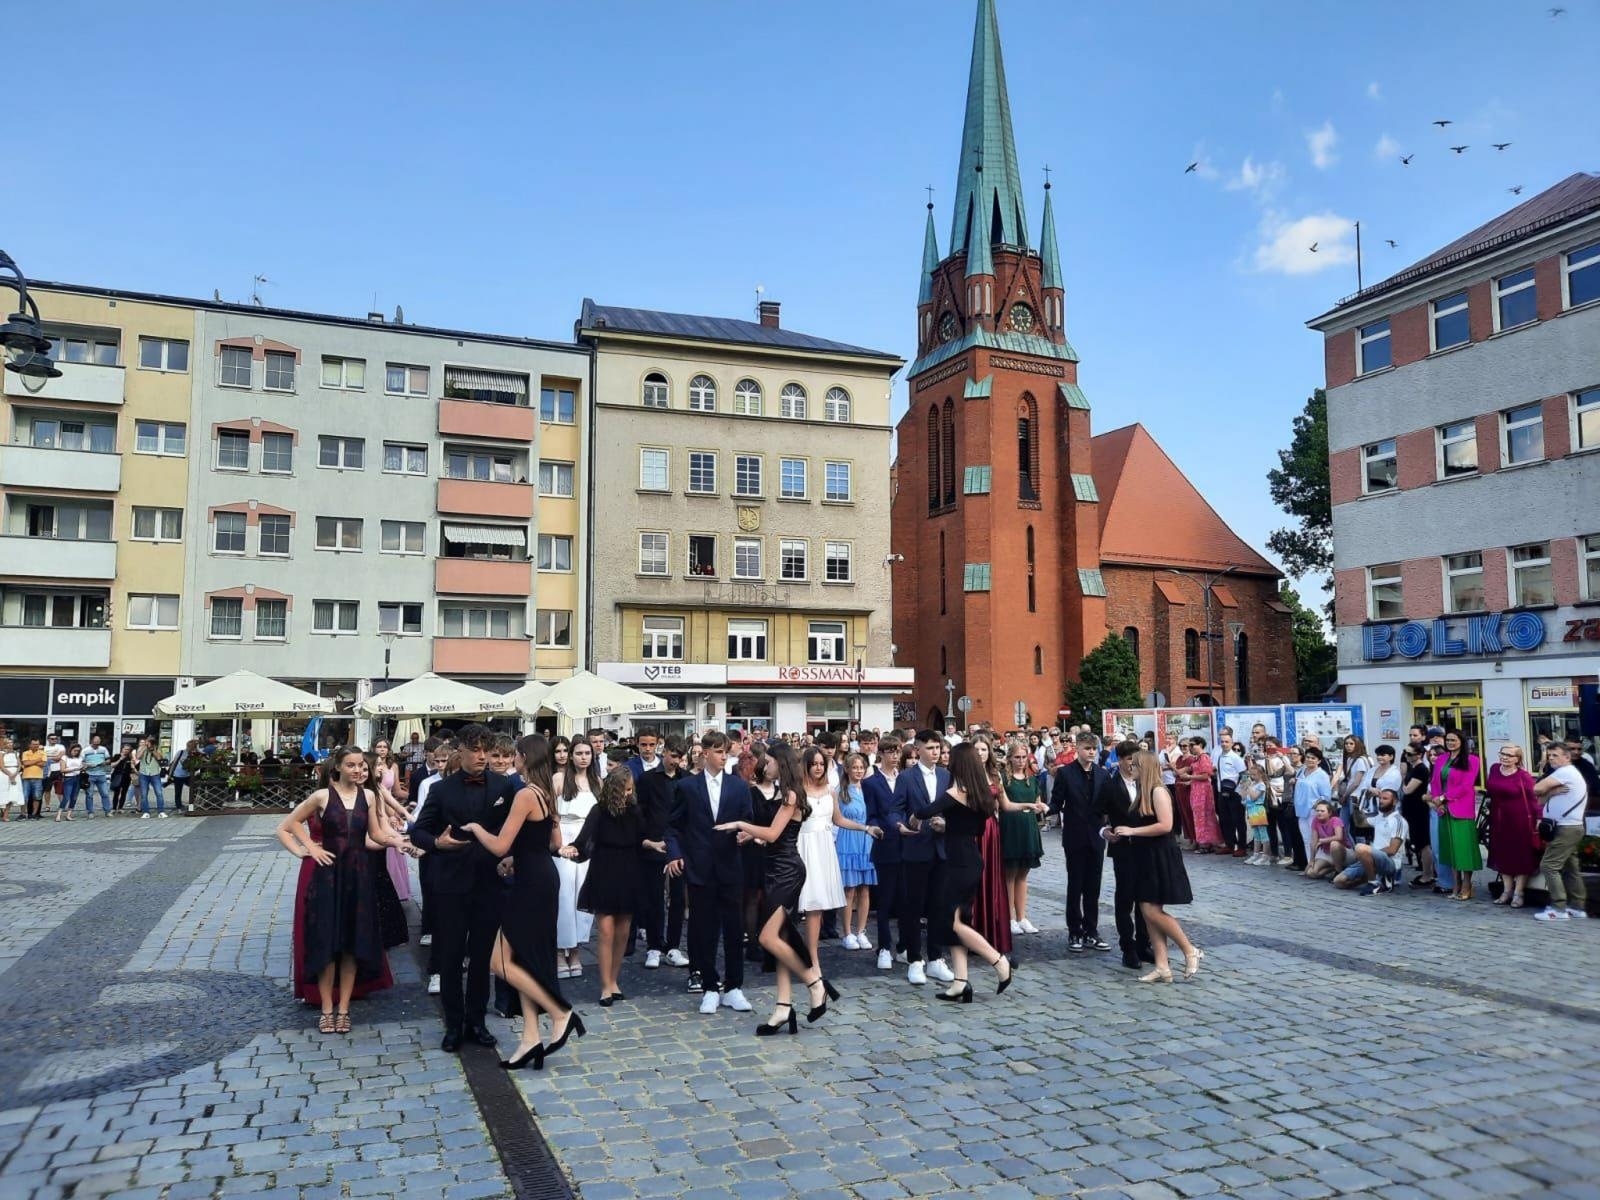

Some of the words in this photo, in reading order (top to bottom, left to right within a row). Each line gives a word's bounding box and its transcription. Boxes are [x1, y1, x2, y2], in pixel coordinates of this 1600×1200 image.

[1362, 611, 1545, 661] BOLKO
[661, 666, 682, 674] TEB
[779, 666, 866, 681] ROSSMANN
[57, 687, 116, 707] empik
[175, 704, 206, 712] Kozel
[235, 702, 265, 711] Kozel
[292, 702, 321, 711] Kozel
[429, 704, 455, 712] Kozel
[588, 705, 612, 716] Kozel
